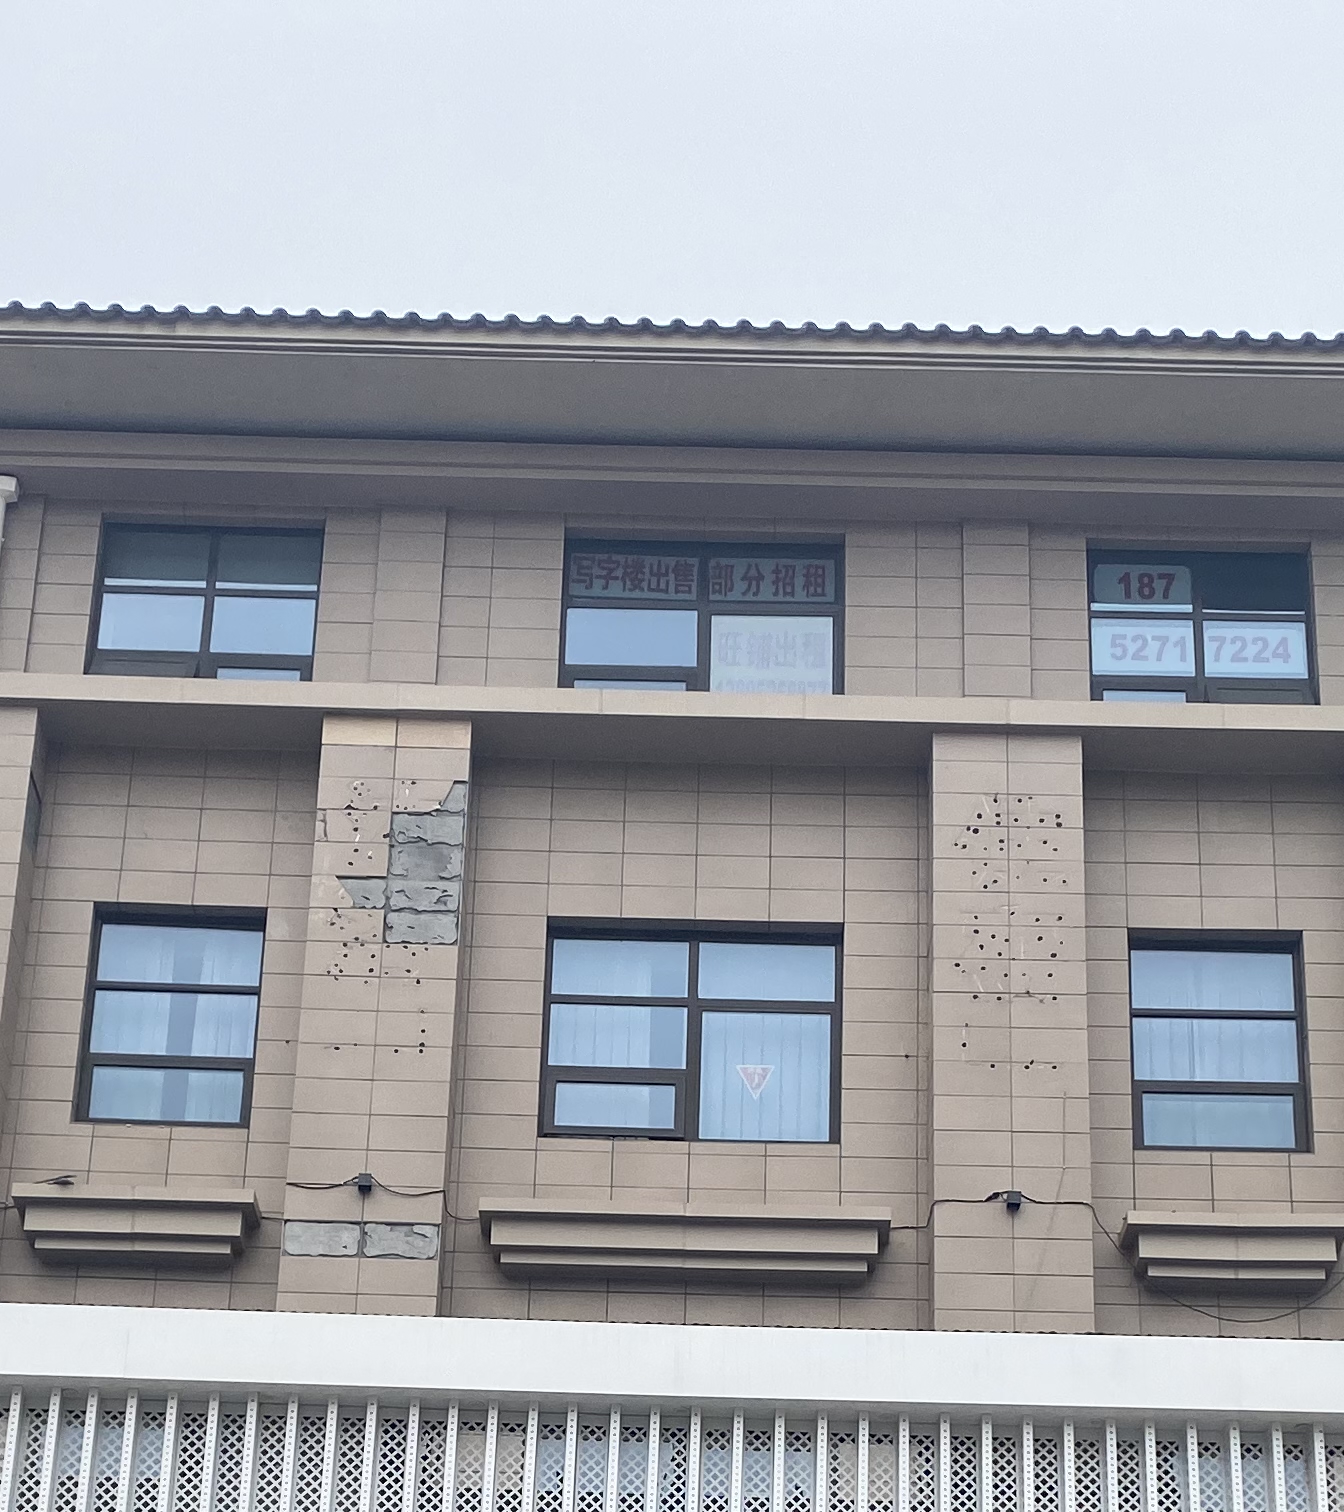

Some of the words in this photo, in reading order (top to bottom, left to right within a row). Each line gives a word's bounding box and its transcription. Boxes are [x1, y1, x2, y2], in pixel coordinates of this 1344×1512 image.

[571, 554, 696, 595] 写字楼出售
[709, 560, 828, 599] 部分招租
[1117, 571, 1176, 600] 187
[1109, 633, 1188, 663] 5271
[1208, 635, 1292, 664] 7224
